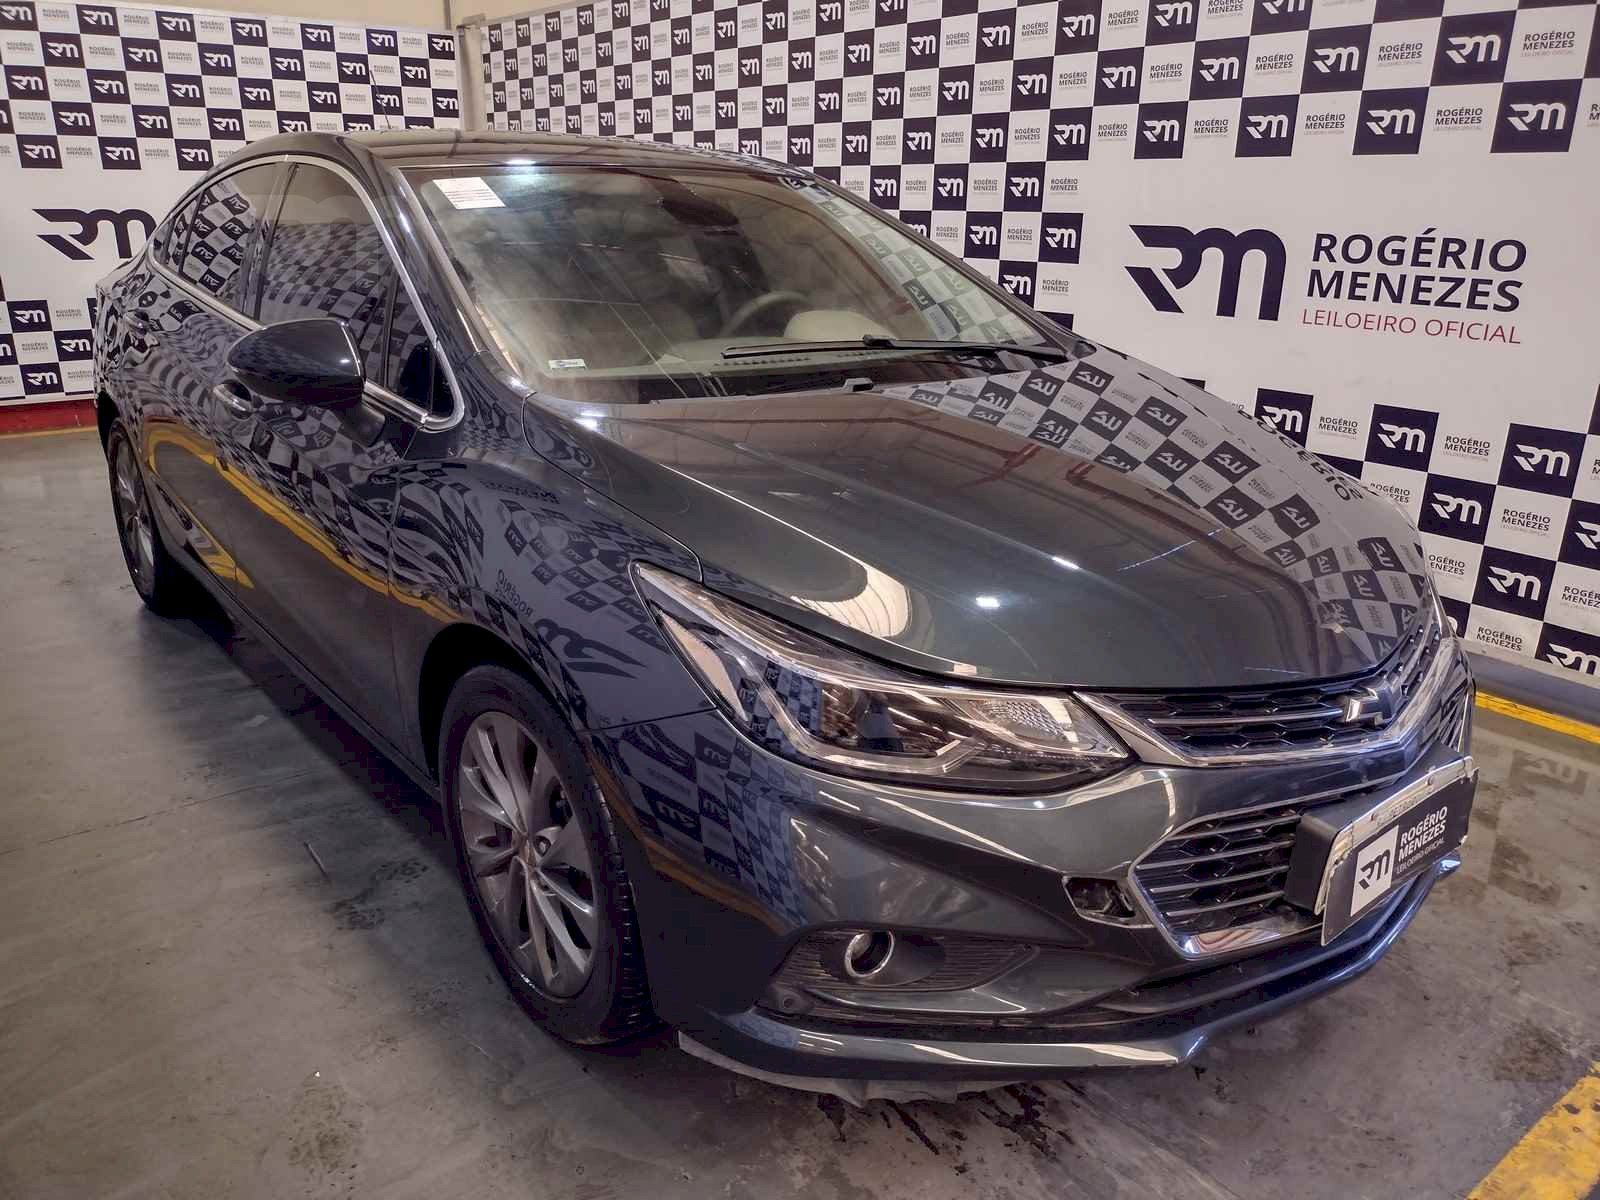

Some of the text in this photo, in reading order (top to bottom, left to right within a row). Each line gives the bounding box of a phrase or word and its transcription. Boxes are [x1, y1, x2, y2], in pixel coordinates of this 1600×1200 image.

[1108, 9, 1139, 19] ROGÉRIO
[1107, 17, 1138, 26] MENEZES
[1022, 28, 1048, 37] MENEZES
[1524, 30, 1575, 42] ROGÉRIO
[1379, 41, 1423, 53] ROGÉRIO
[1523, 40, 1574, 50] MENEZES
[1256, 53, 1294, 63] ROGÉRIO
[1378, 51, 1422, 61] MENEZES
[1151, 63, 1182, 72] ROGÉRIO
[1255, 61, 1293, 71] MENEZES
[1059, 71, 1087, 80] ROGÉRIO
[1150, 70, 1182, 79] MENEZES
[1059, 78, 1087, 86] MENEZES
[1306, 112, 1346, 122] ROGÉRIO
[1436, 106, 1483, 118] ROGÉRIO
[1194, 118, 1229, 127] ROGÉRIO
[1305, 121, 1345, 130] MENEZES
[1435, 116, 1482, 126] MENEZES
[1098, 123, 1127, 131] ROGÉRIO
[1193, 126, 1228, 134] MENEZES
[1097, 129, 1127, 137] MENEZES
[1312, 228, 1527, 273] ROGÉRIO
[1307, 270, 1523, 313] MENEZES
[1302, 308, 1521, 345] LEILOEIRO OFICIAL
[1320, 416, 1358, 427] ROGÉRIO
[1319, 423, 1357, 434] MENEZES
[1446, 435, 1490, 449] ROGÉRIO
[1444, 443, 1489, 456] MENEZES
[1503, 509, 1550, 524] ROGÉRIO
[1502, 517, 1550, 531] MENEZES
[1429, 555, 1465, 568] OGÉRIO
[1430, 562, 1465, 575] ENEZES
[1563, 585, 1600, 600] ROGÉR
[1562, 594, 1600, 608] MENEZ
[1478, 627, 1522, 644] ROGÉRIO
[1476, 633, 1522, 651] MENEZES
[1401, 806, 1448, 846] ROGÉRIO
[1399, 820, 1446, 862] MENEZES
